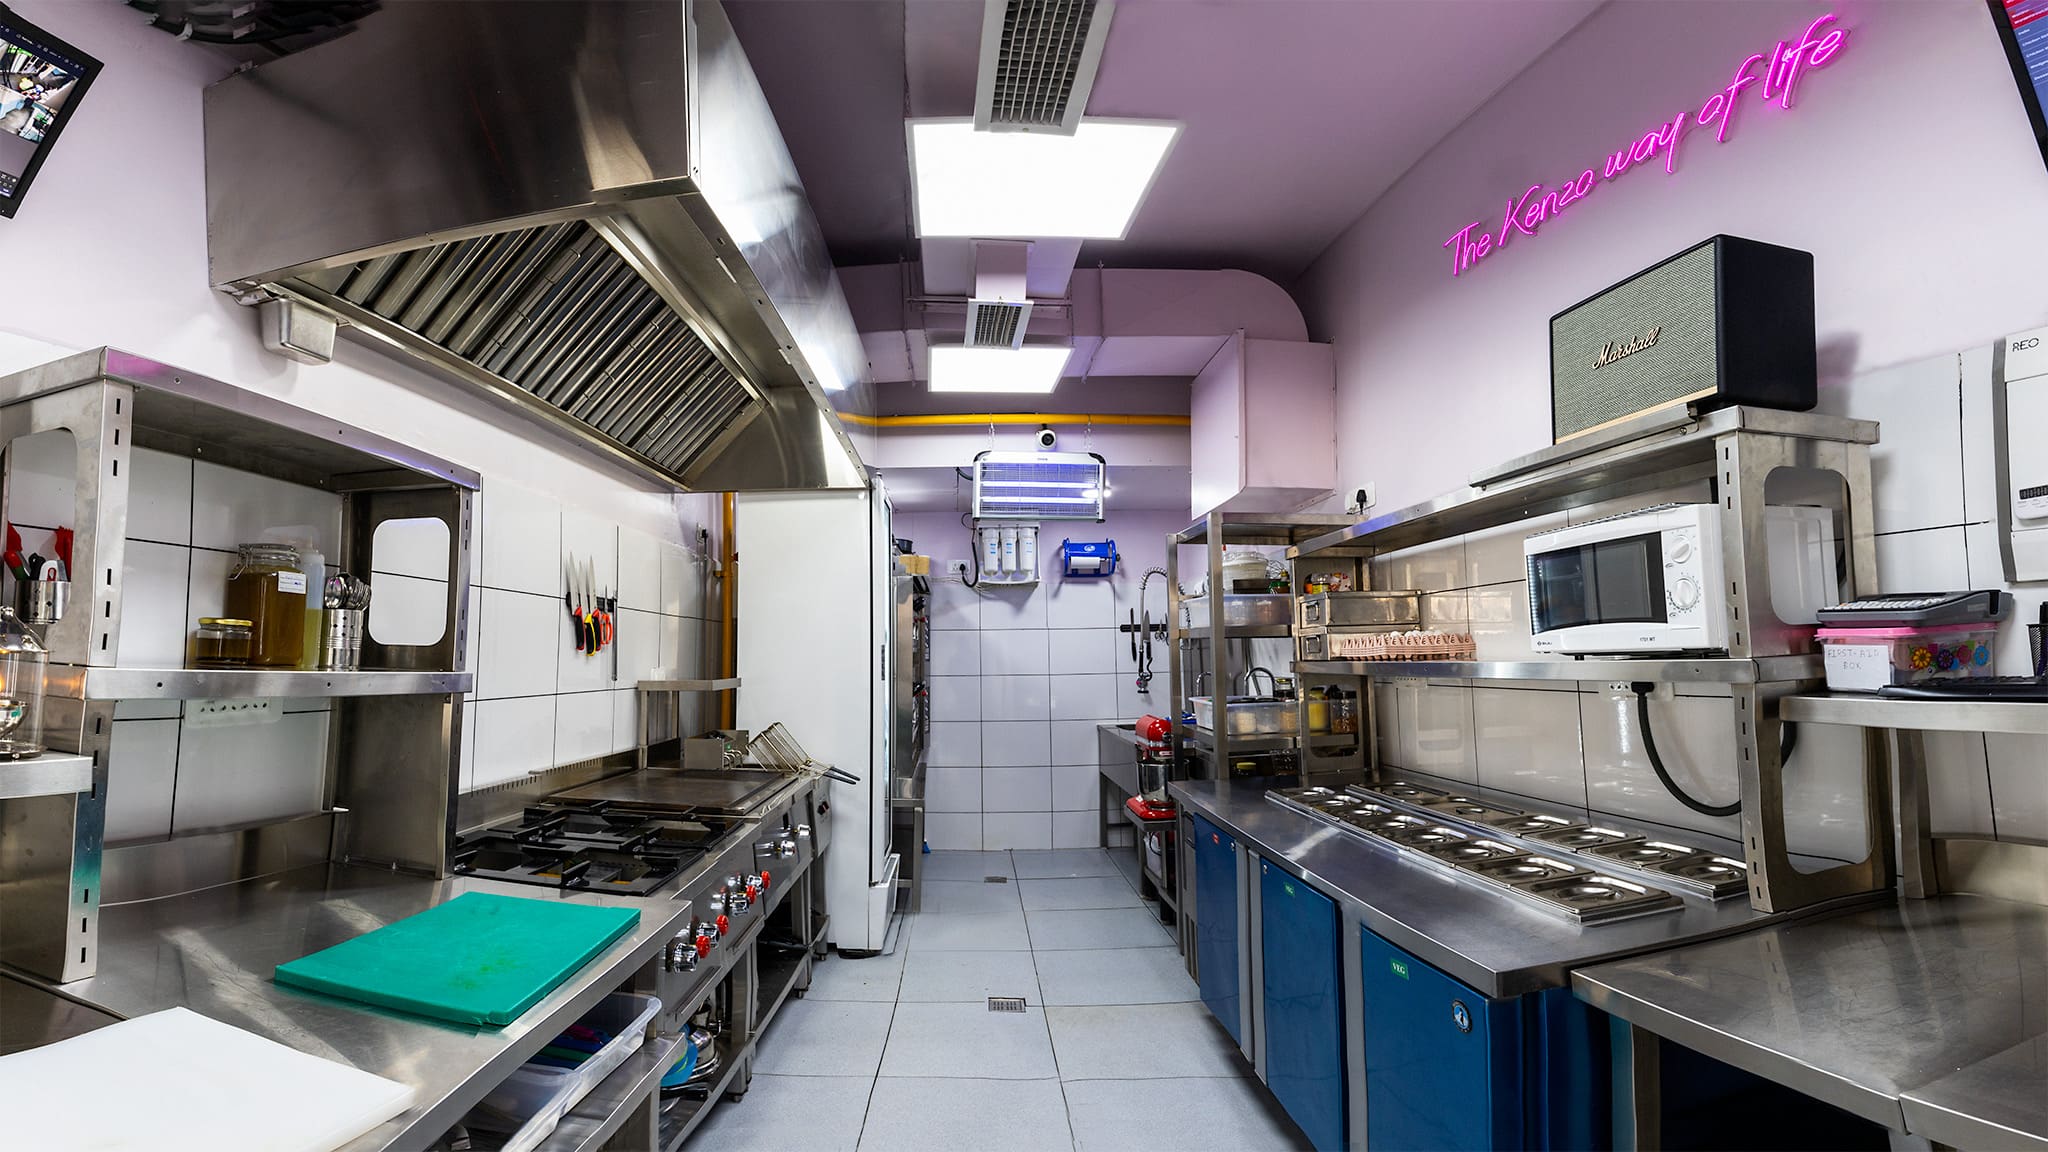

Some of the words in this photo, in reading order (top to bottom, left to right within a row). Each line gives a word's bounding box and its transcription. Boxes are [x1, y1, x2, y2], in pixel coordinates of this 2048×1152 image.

[1443, 222, 1492, 276] The
[1498, 169, 1597, 247] Kenzo
[1603, 111, 1687, 175] way
[1697, 53, 1763, 143] of
[1762, 13, 1845, 109] life
[1592, 326, 1662, 370] Marshall
[2012, 337, 2040, 352] REO
[1392, 961, 1406, 975] VEG
